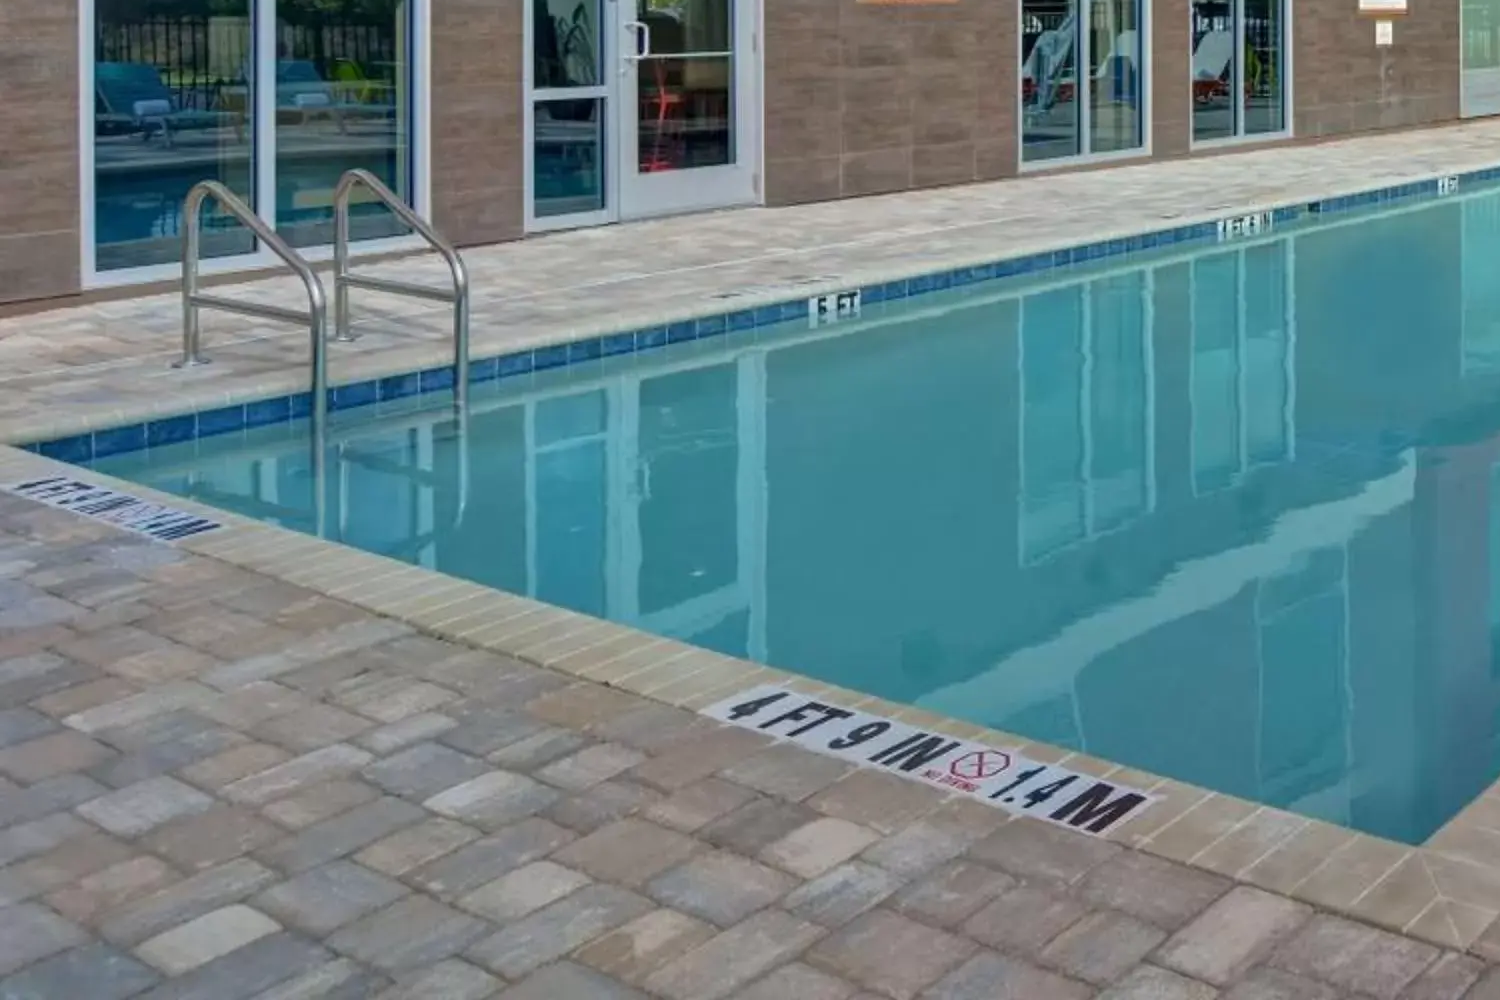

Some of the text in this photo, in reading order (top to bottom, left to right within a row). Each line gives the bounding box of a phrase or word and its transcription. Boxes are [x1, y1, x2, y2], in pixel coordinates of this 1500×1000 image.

[837, 291, 858, 311] FT
[727, 690, 1148, 833] 4 FT 9 IN 1.4 M
